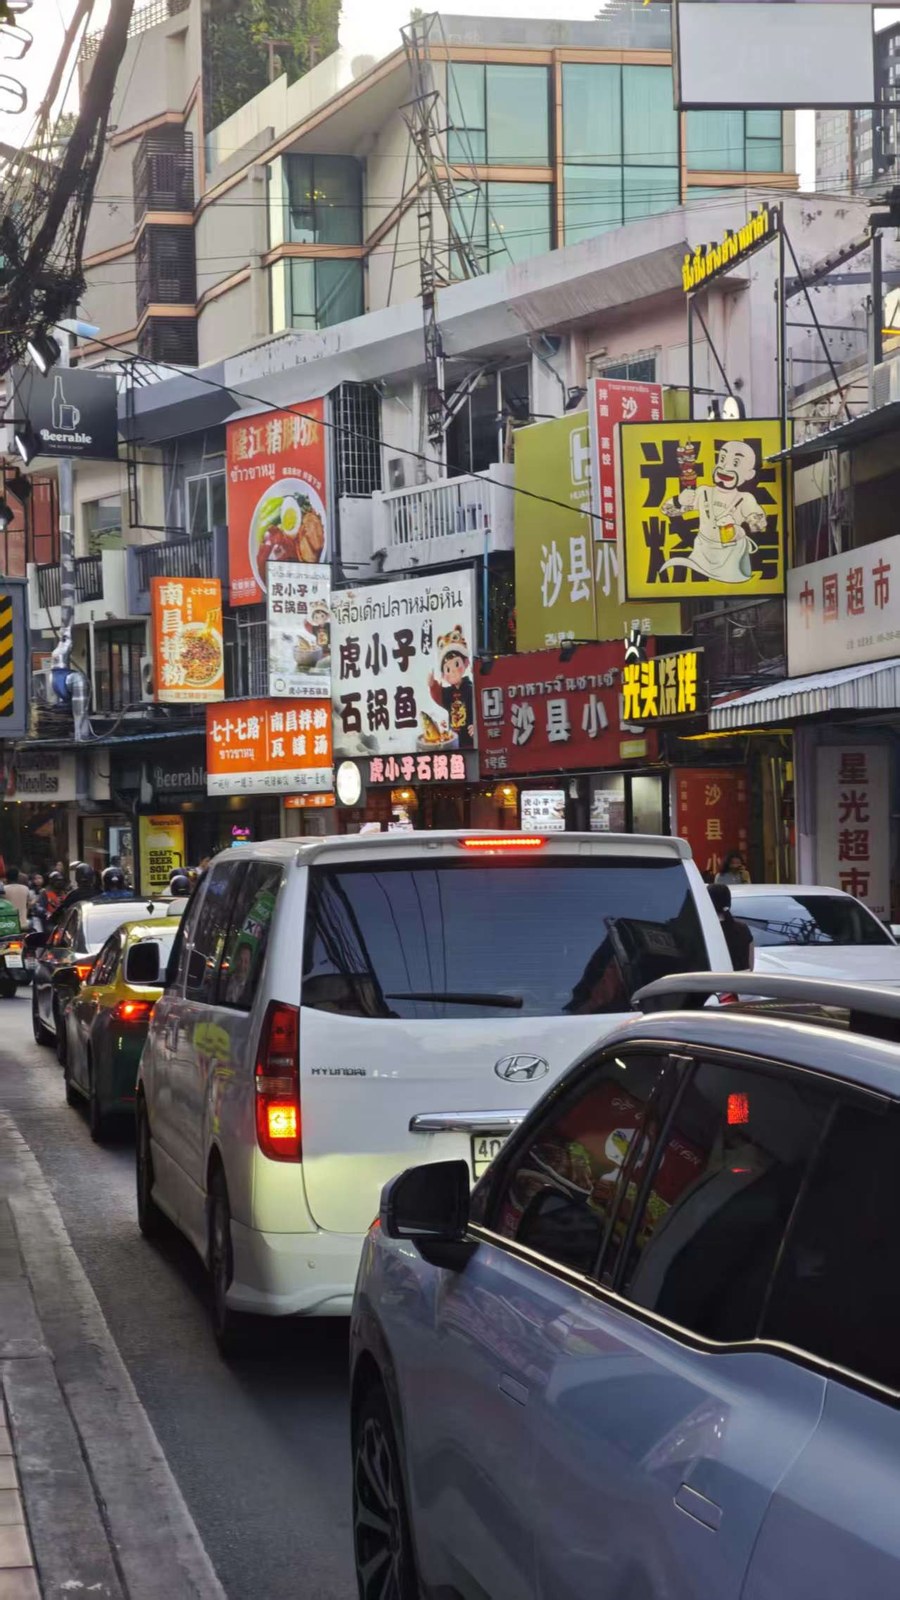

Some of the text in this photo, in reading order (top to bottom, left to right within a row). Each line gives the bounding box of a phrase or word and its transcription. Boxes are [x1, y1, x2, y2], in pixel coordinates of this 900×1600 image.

[621, 396, 638, 419] 沙
[40, 429, 92, 444] Beerable
[540, 535, 619, 608] 沙县小
[272, 583, 308, 597] 虎小子
[799, 557, 891, 629] 中国超市
[272, 600, 308, 615] 石锅鱼
[338, 588, 463, 624] เสือเด็กปลาหม้อหิน
[339, 628, 416, 680] 虎小子
[623, 652, 697, 720] 光头烧烤
[270, 708, 328, 732] 南昌拌粉
[340, 686, 418, 734] 石锅鱼
[210, 716, 260, 742] 七十七路
[271, 734, 328, 758] 瓦罐汤
[369, 754, 466, 783] 虎小子石锅鱼
[704, 785, 723, 875] 沙县小
[837, 752, 870, 897] 星光超市
[311, 1067, 366, 1076] HYUNDAI
